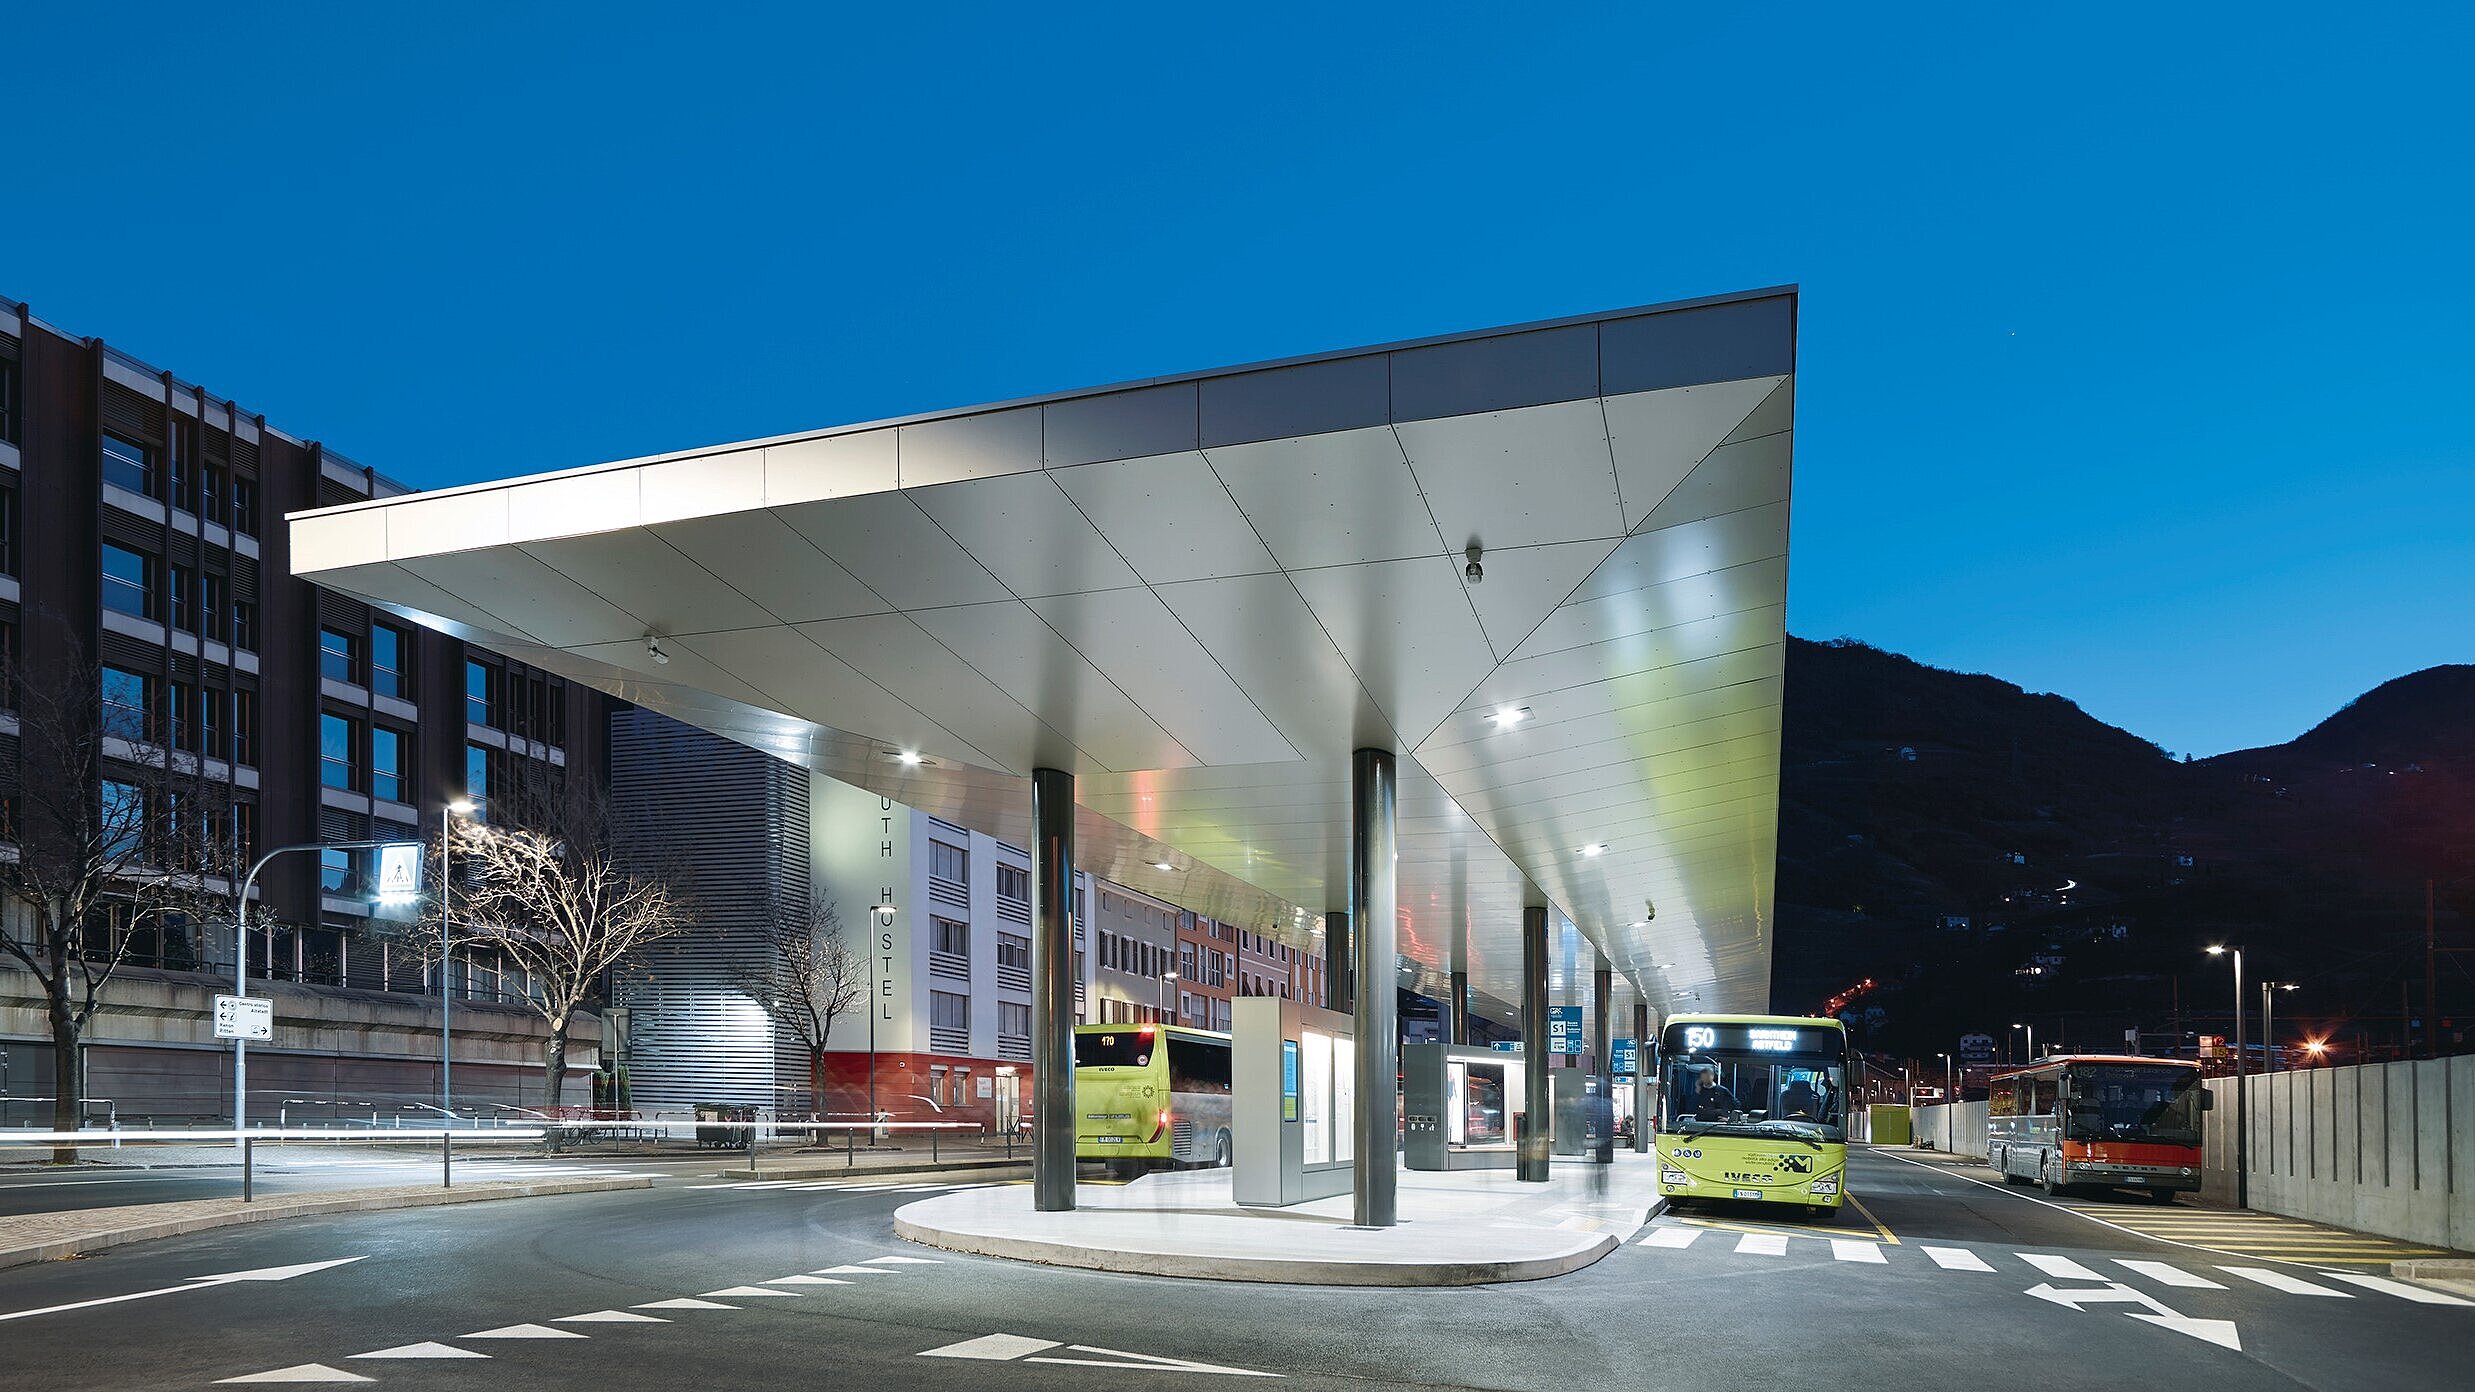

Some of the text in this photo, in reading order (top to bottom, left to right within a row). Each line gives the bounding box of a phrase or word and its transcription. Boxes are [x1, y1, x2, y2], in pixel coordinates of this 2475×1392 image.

[881, 887, 893, 1020] HOSTEL
[1552, 1024, 1565, 1033] S1
[1101, 1036, 1115, 1046] 170
[1684, 1027, 1715, 1048] 150
[1724, 1172, 1774, 1183] IVECO
